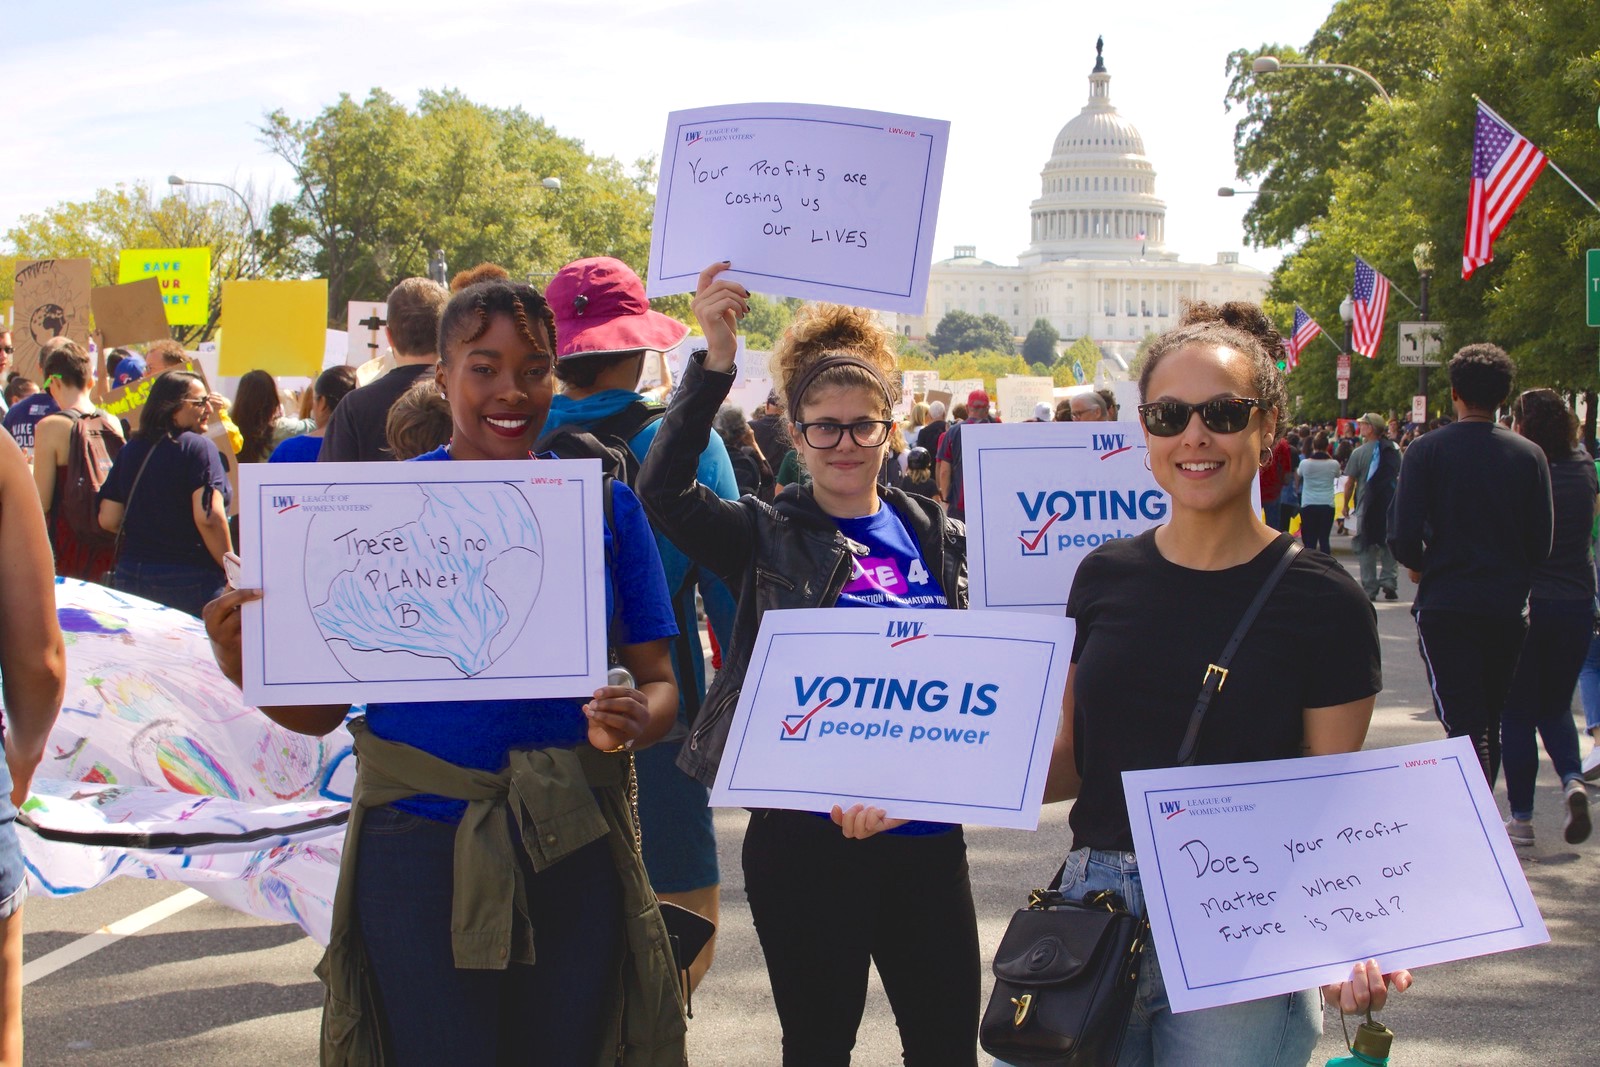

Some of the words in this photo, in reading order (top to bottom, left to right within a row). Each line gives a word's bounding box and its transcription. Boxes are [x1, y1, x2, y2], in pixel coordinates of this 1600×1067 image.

[686, 131, 701, 141] LWV
[889, 127, 915, 138] LWV.org
[689, 157, 728, 183] Your
[749, 159, 825, 182] Profits
[844, 173, 867, 186] are
[801, 197, 820, 212] us
[811, 228, 867, 248] LIVES
[143, 262, 180, 272] SAVE
[161, 280, 181, 289] UR
[161, 295, 190, 305] NET
[1400, 355, 1420, 363] ONLY
[1092, 434, 1125, 450] LWV
[273, 496, 295, 508] LWV
[302, 495, 336, 503] LEAGUE
[1016, 489, 1167, 522] VOTING
[334, 527, 408, 555] There
[427, 534, 449, 555] is
[464, 538, 486, 552] no
[907, 558, 929, 585] 4
[393, 602, 421, 628] B
[886, 620, 925, 638] LWV
[794, 676, 948, 713] VOTING
[959, 682, 1000, 716] IS
[818, 718, 904, 741] people
[909, 725, 990, 745] power
[1404, 759, 1437, 769] LWV.org
[1159, 800, 1181, 814] LWV
[1187, 797, 1219, 806] LEAGUE
[1189, 807, 1221, 816] WOMEN
[1179, 839, 1259, 879] Does
[1336, 821, 1408, 844] Profit
[1382, 861, 1412, 878] our
[1304, 915, 1328, 931] is
[1331, 895, 1404, 924] Dead?
